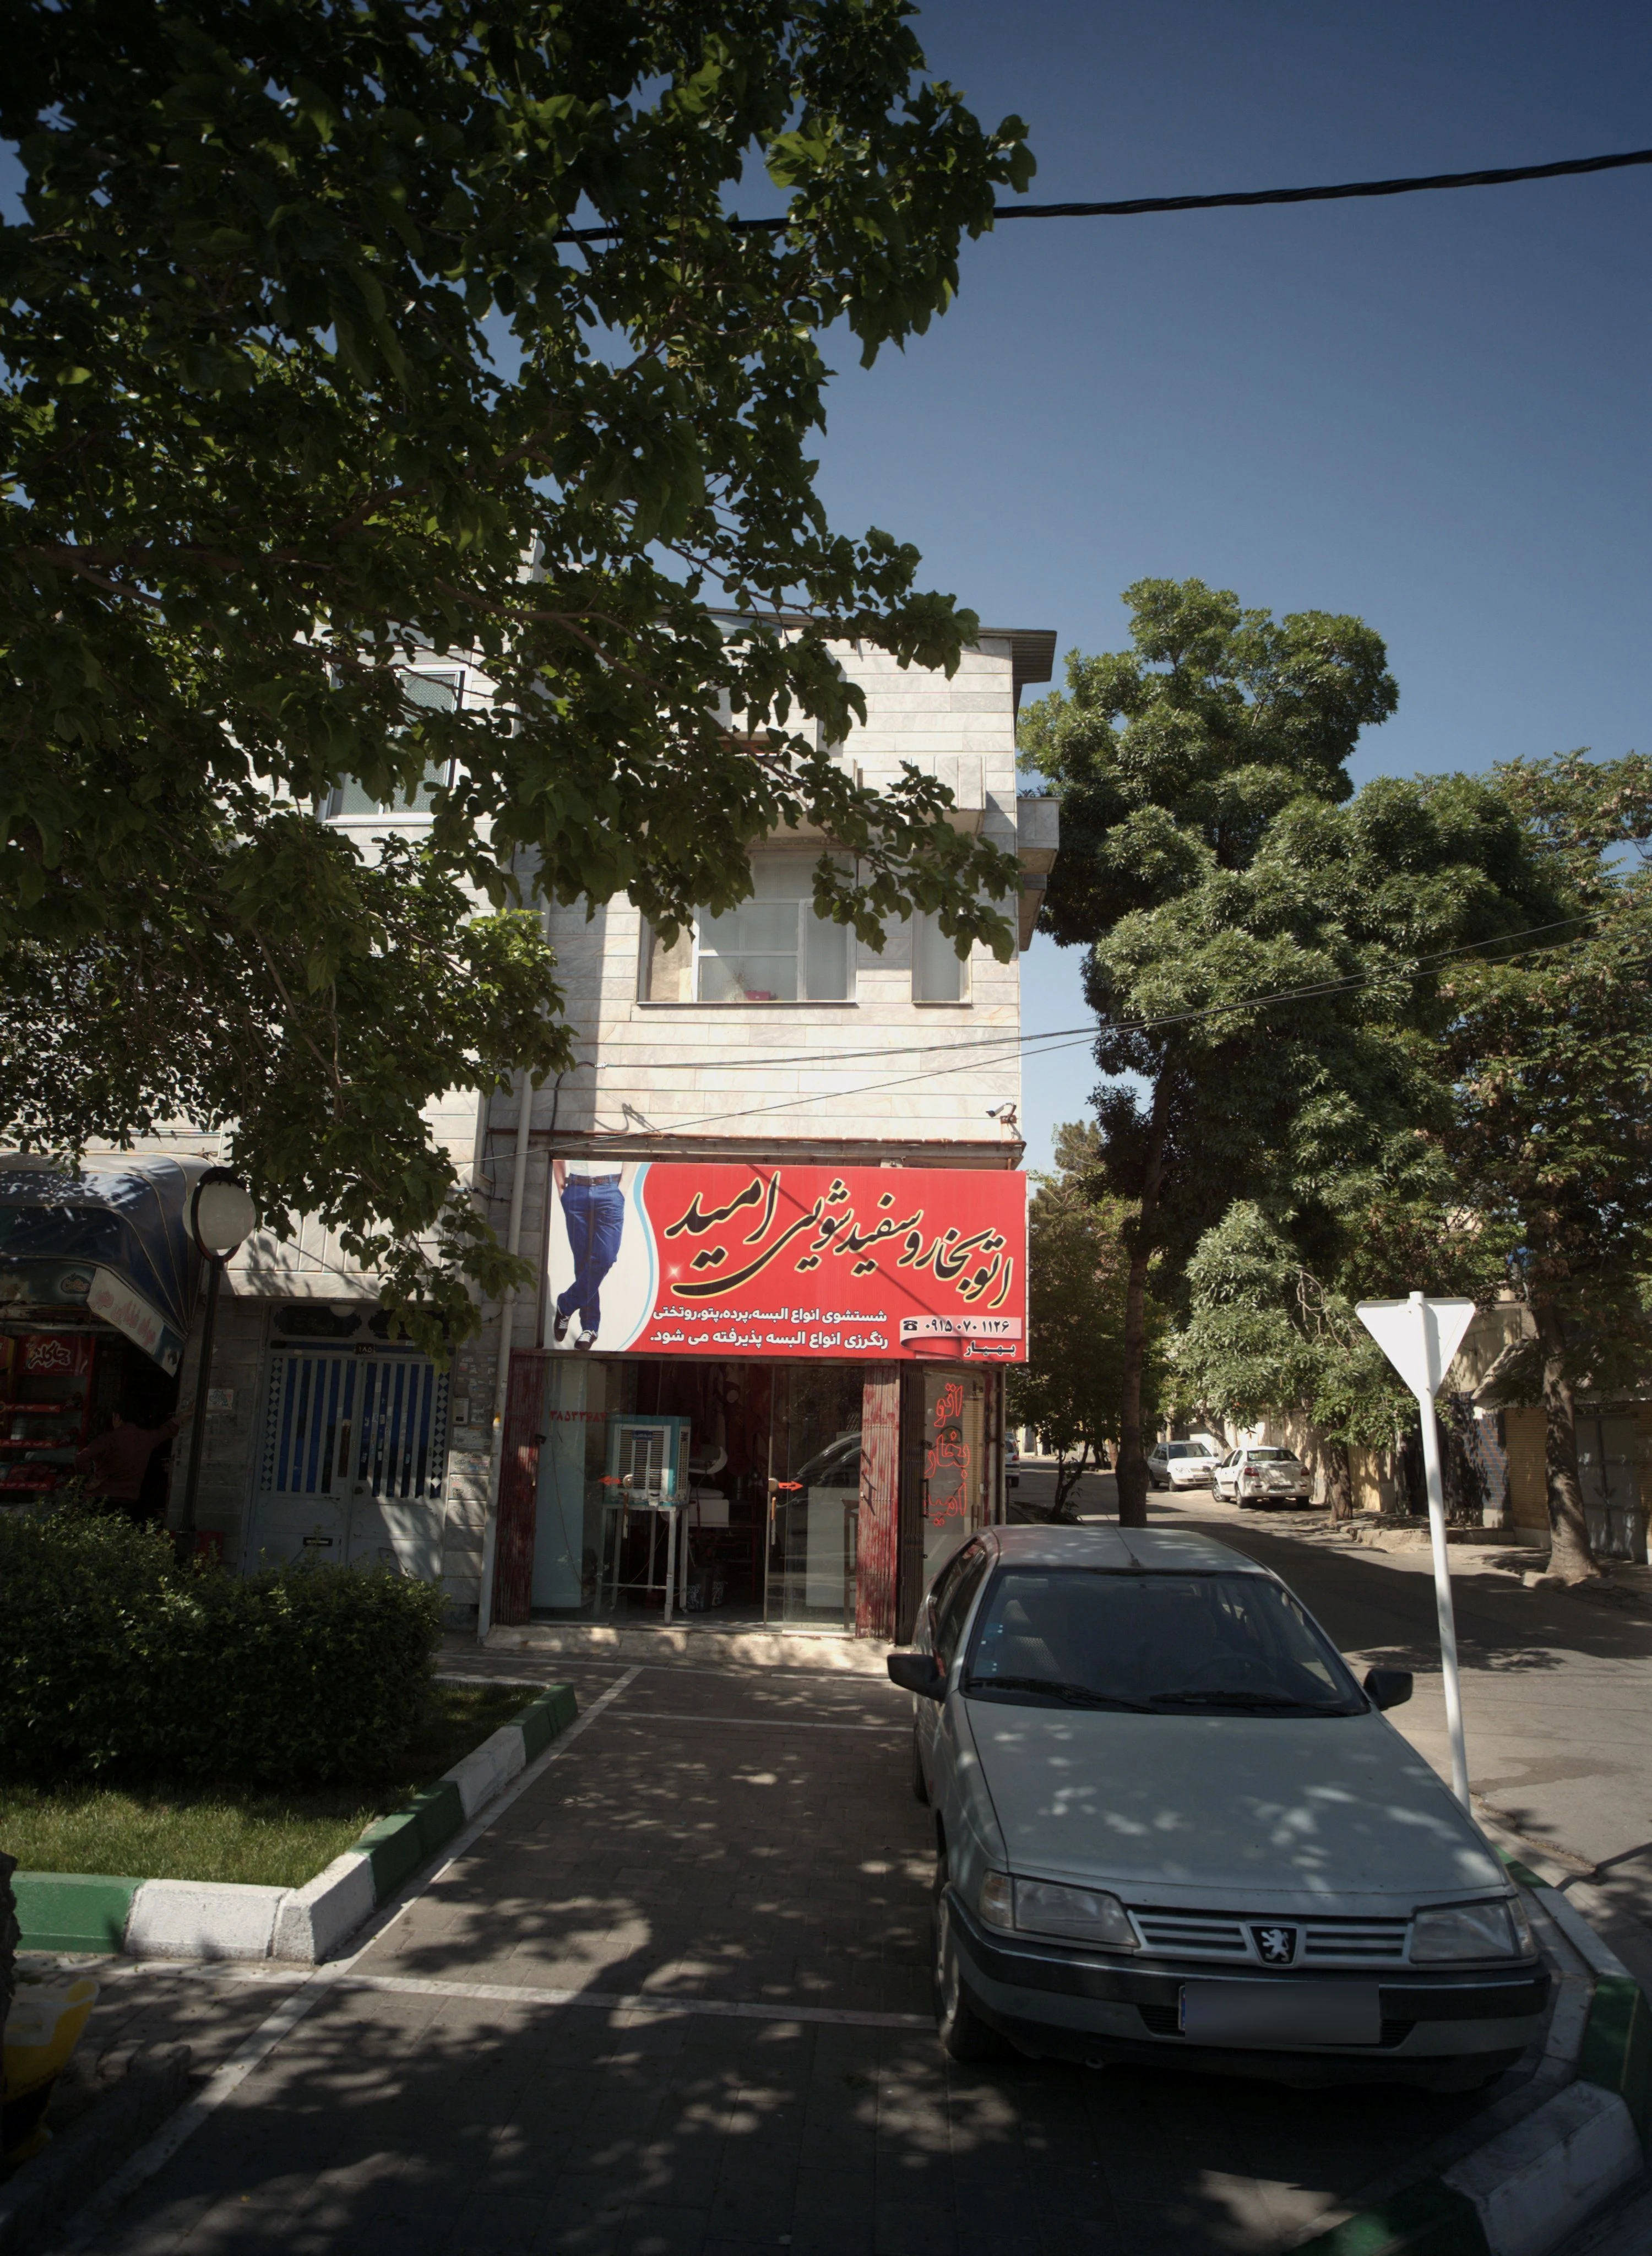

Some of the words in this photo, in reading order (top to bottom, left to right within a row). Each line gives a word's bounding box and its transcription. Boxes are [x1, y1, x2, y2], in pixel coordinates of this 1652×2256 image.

[664, 1170, 781, 1271] امید
[791, 1308, 819, 1324] انواع
[822, 1309, 887, 1324] شستشوی
[925, 1319, 952, 1333] ۰۹۱۵
[957, 1320, 977, 1333] ۰۷۰
[982, 1320, 1009, 1333] ۱۱۲۶
[650, 1328, 684, 1344] شود.
[688, 1333, 709, 1345] می
[713, 1327, 762, 1348] پذیرفته
[766, 1331, 806, 1348] البسه
[809, 1331, 841, 1348] انواع
[844, 1331, 888, 1349] رنگرزی
[964, 1340, 1015, 1357] بهیار
[934, 1383, 963, 1428] اتو
[924, 1430, 970, 1479] بخار
